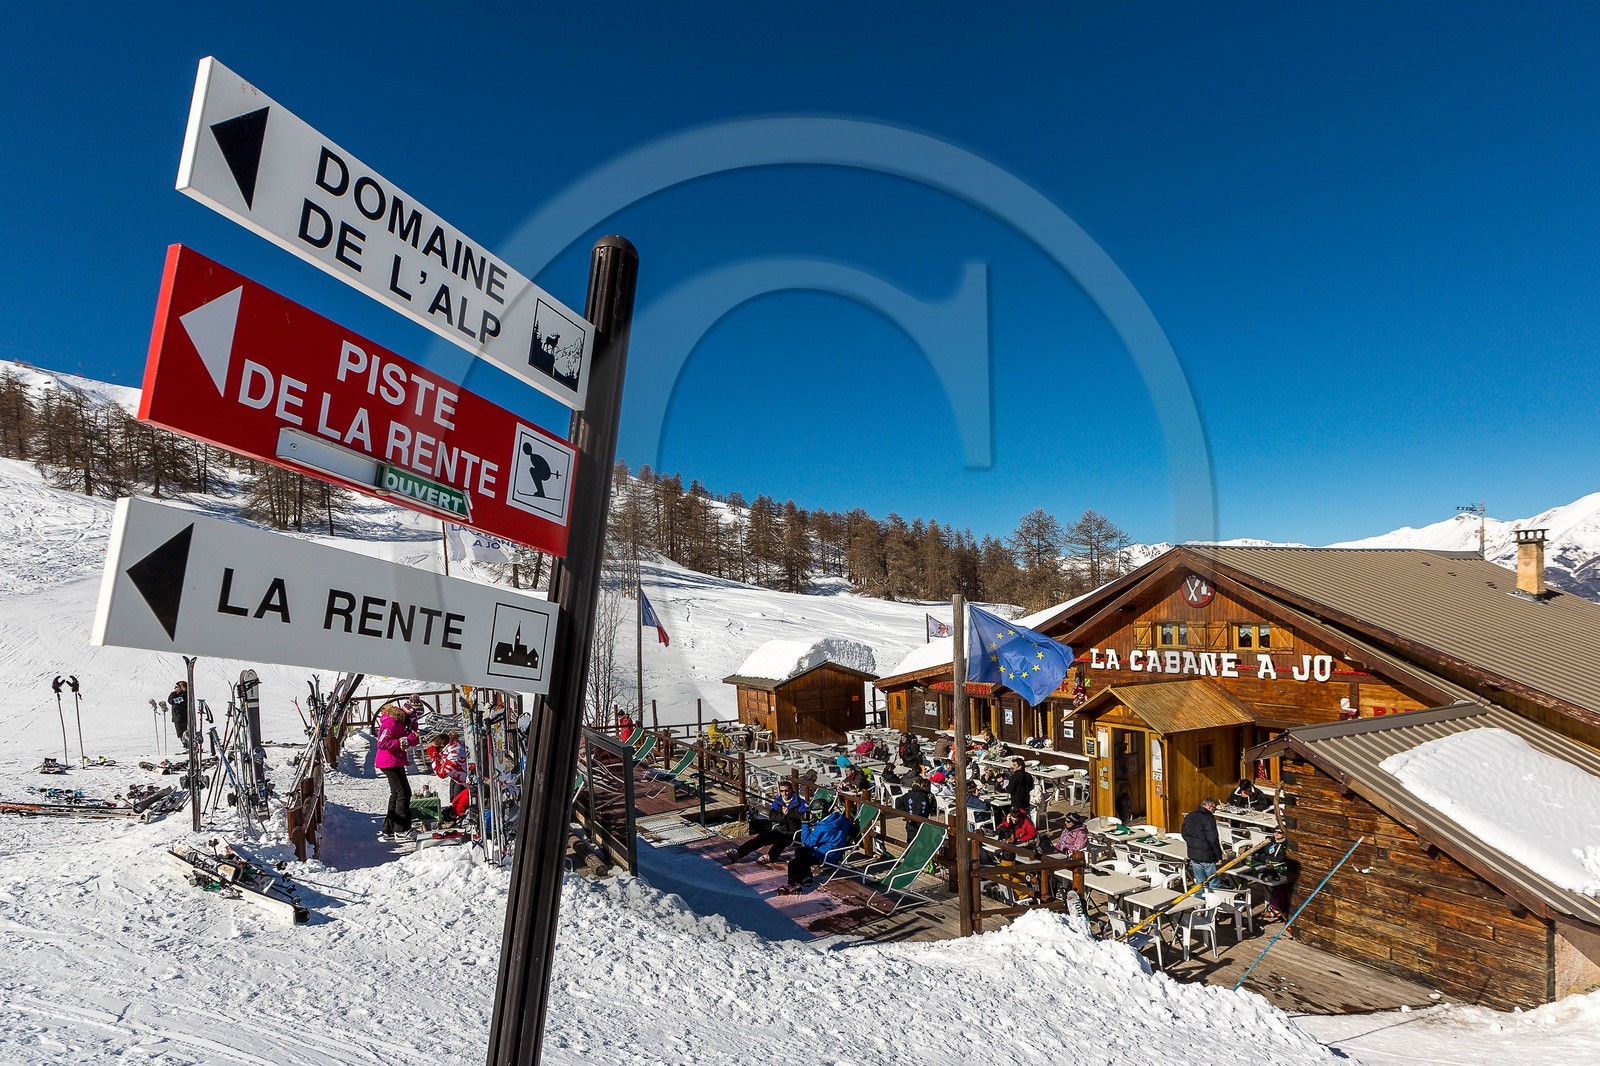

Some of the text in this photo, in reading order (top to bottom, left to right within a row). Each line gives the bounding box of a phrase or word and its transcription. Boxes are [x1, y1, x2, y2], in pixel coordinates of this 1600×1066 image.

[315, 145, 509, 306] DOMAINE
[298, 197, 502, 344] DE L'ALP
[238, 358, 499, 498] DE LA RENTE
[337, 340, 459, 431] PISTE
[385, 473, 464, 512] OUVERT
[486, 541, 500, 550] JO
[217, 567, 466, 650] LA RENTE
[1090, 648, 1333, 682] LA CABANE A JO
